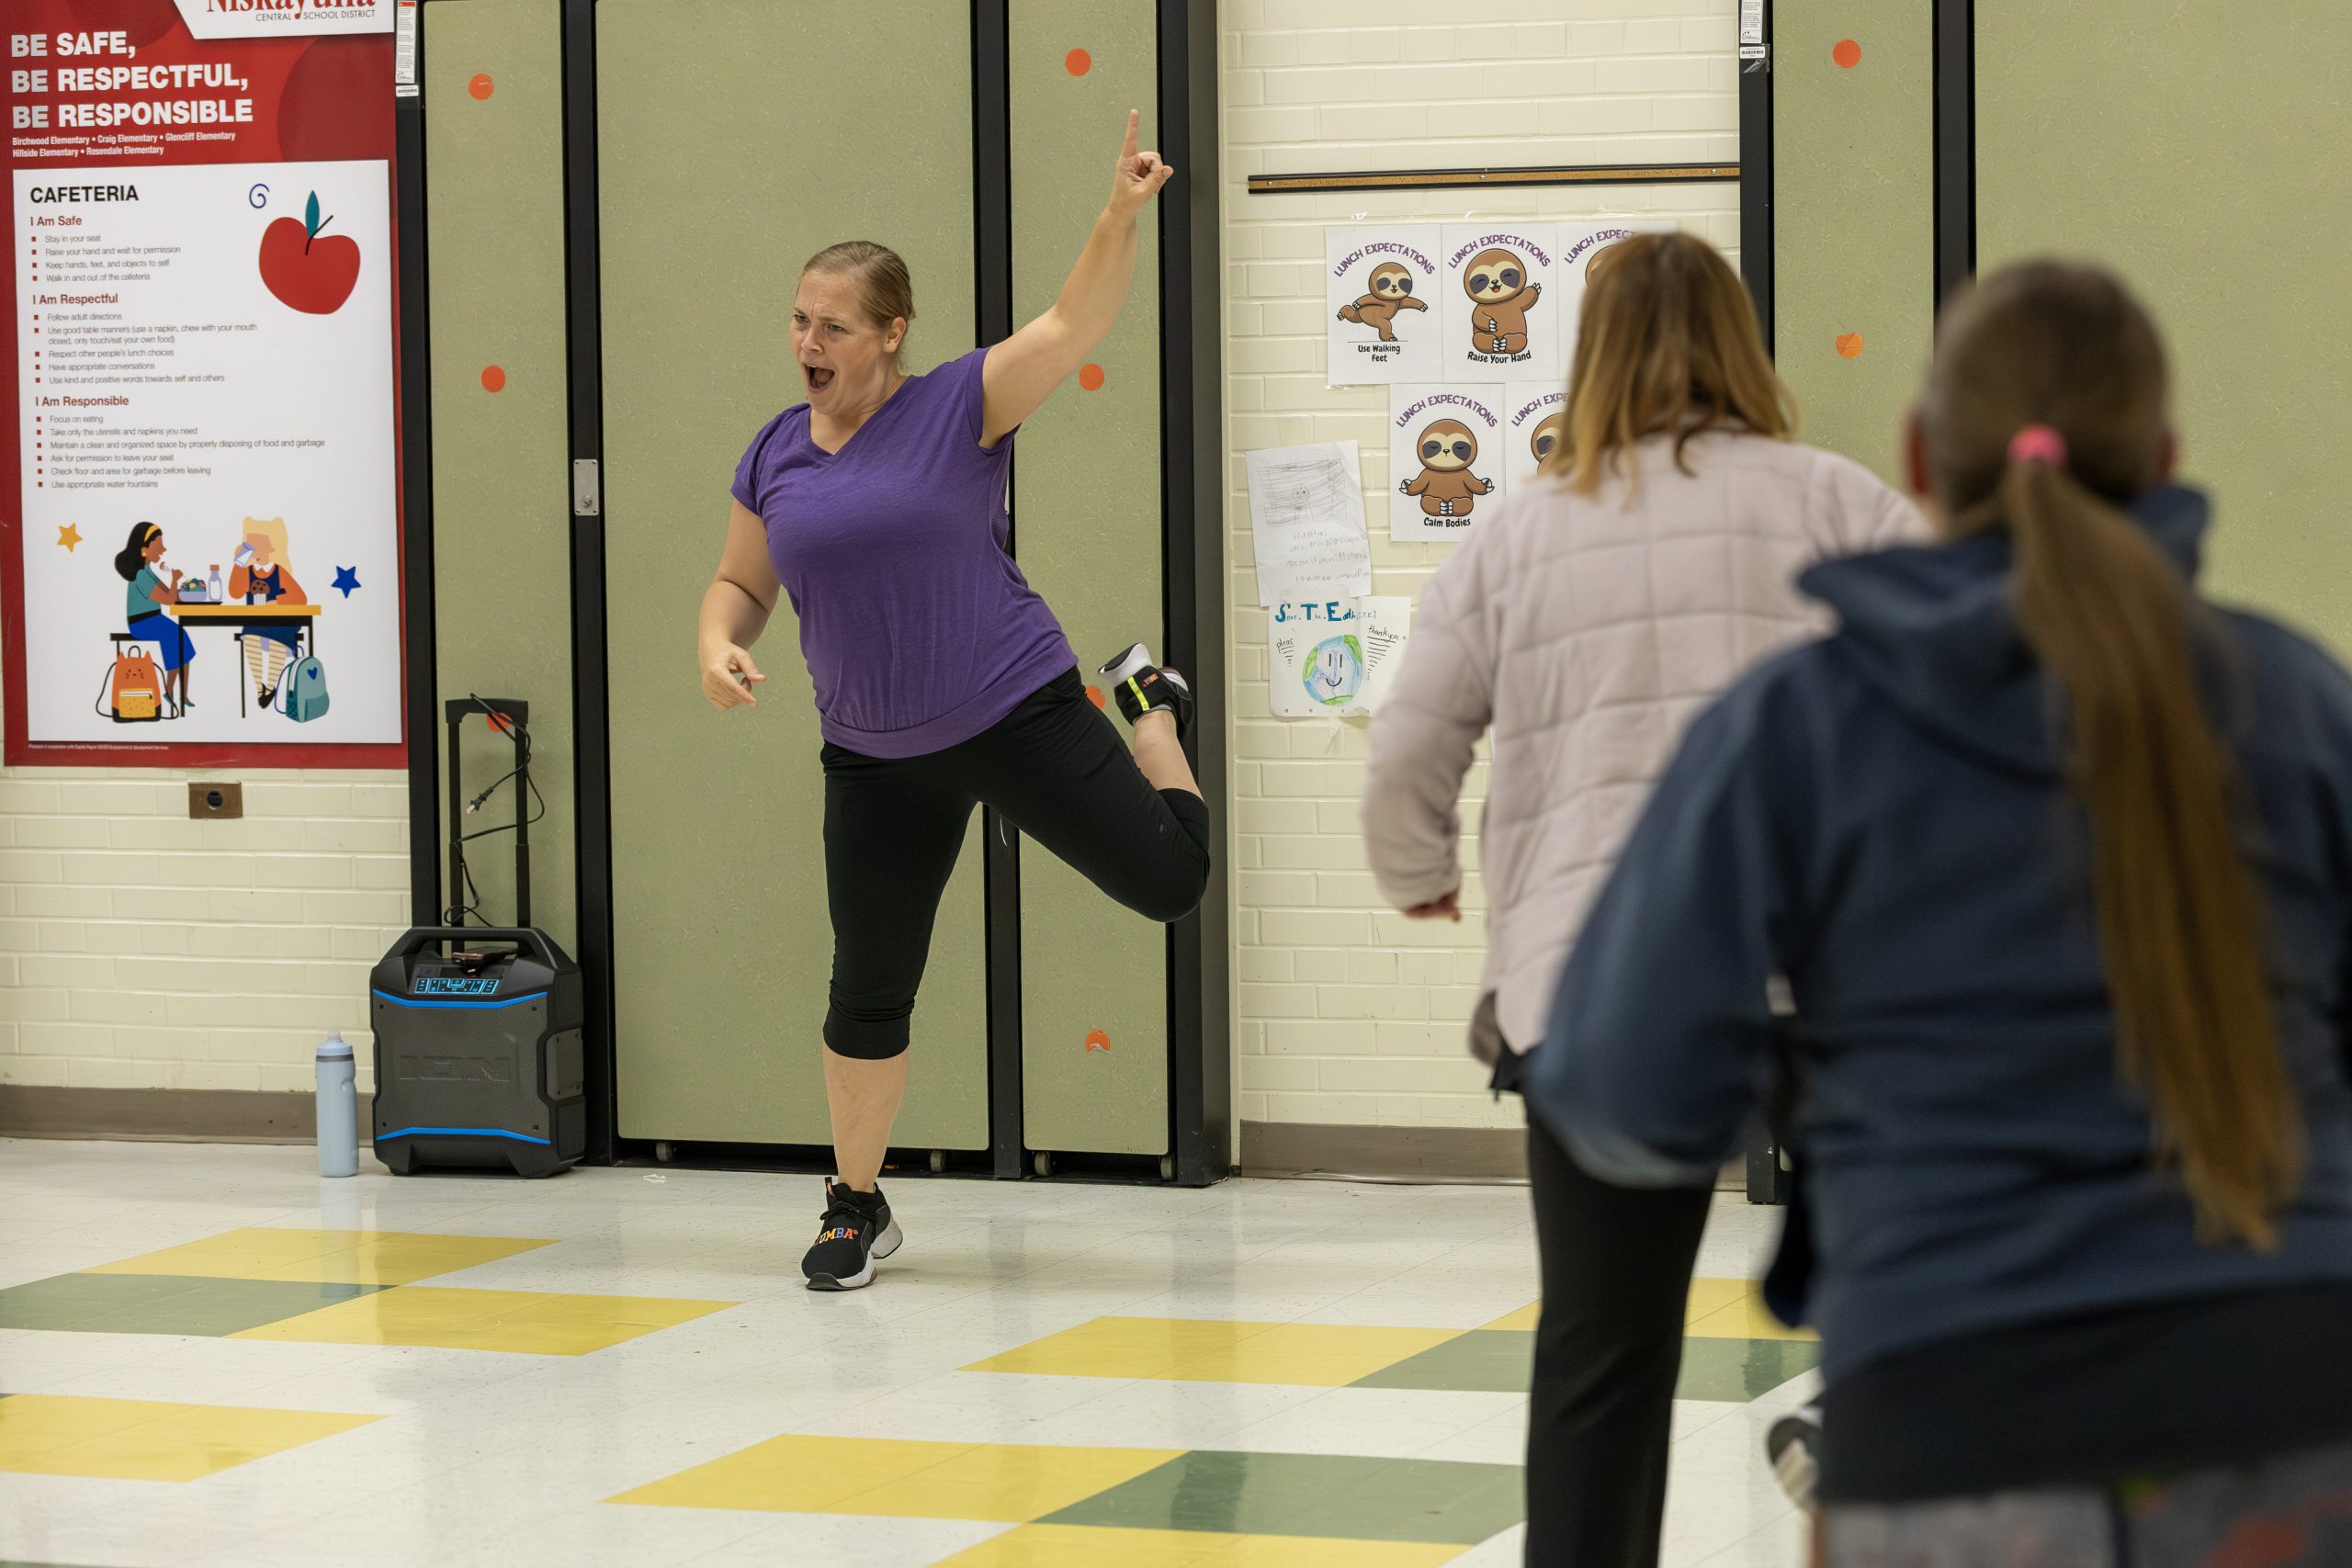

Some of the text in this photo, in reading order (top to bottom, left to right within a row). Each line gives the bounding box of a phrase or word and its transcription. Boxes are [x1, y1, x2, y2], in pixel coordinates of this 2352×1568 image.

[254, 12, 291, 21] CENTRAL
[302, 9, 375, 19] SCHOOL DISTRICT
[11, 30, 136, 59] BE SAFE,
[11, 62, 248, 92] BE RESPECTFUL,
[12, 98, 253, 128] BE RESPONSIBLE
[12, 131, 235, 145] Birchwood Elementary Craig Elementary Glencliff Elementary
[12, 145, 164, 157] Hillside Elementary Rosendale Elementary
[29, 185, 138, 203] CAFETERIA
[29, 215, 82, 226] I Am Safe
[44, 234, 61, 243] Stay
[69, 235, 85, 243] your
[142, 245, 181, 254] permission
[1448, 234, 1551, 269] LUNCH EXPECTATIONS
[1565, 236, 1594, 264] LUNCH
[44, 261, 64, 269] Keep
[89, 260, 105, 268] feet,
[121, 259, 147, 268] objects
[156, 258, 169, 266] self
[1334, 243, 1435, 277] LUNCH EXPECTATIONS
[99, 273, 107, 281] of
[119, 272, 151, 280] cafeteria
[31, 292, 118, 306] I Am Respectful
[46, 312, 70, 321] Follow
[46, 326, 62, 334] Use
[62, 326, 81, 335] good
[82, 325, 99, 333] table
[153, 324, 179, 333] napkin,
[180, 323, 199, 332] chew
[217, 324, 232, 333] your
[233, 322, 257, 331] mouth
[47, 336, 73, 344] closed,
[74, 337, 88, 345] only
[156, 334, 175, 344] food)
[47, 349, 77, 358] Respect
[77, 349, 96, 357] other
[96, 349, 126, 358] people's
[127, 348, 146, 356] lunch
[1358, 344, 1400, 355] Use Walking
[1467, 350, 1532, 364] Raise Your Hand
[48, 362, 154, 371] Have appropriate conversations
[48, 376, 63, 384] Use
[94, 376, 121, 384] positive
[144, 374, 173, 382] towards
[173, 374, 186, 382] self
[35, 395, 129, 408] I Am Responsible
[1396, 394, 1498, 427] LUNCH EXPECTATIONS
[1511, 399, 1542, 426] LUNCH
[48, 414, 71, 423] Focus
[82, 415, 104, 423] eating
[66, 428, 81, 436] only
[95, 427, 121, 435] utensils
[136, 427, 164, 435] napkins
[164, 428, 178, 436] you
[50, 441, 79, 449] Maintain
[120, 440, 154, 450] organized
[178, 440, 187, 449] by
[188, 440, 217, 448] properly
[218, 439, 253, 448] disposing
[295, 438, 325, 448] garbage
[50, 467, 74, 475] Check
[74, 467, 90, 475] floor
[132, 467, 162, 476] garbage
[186, 467, 211, 476] leaving
[1424, 517, 1471, 527] Calm Bodies
